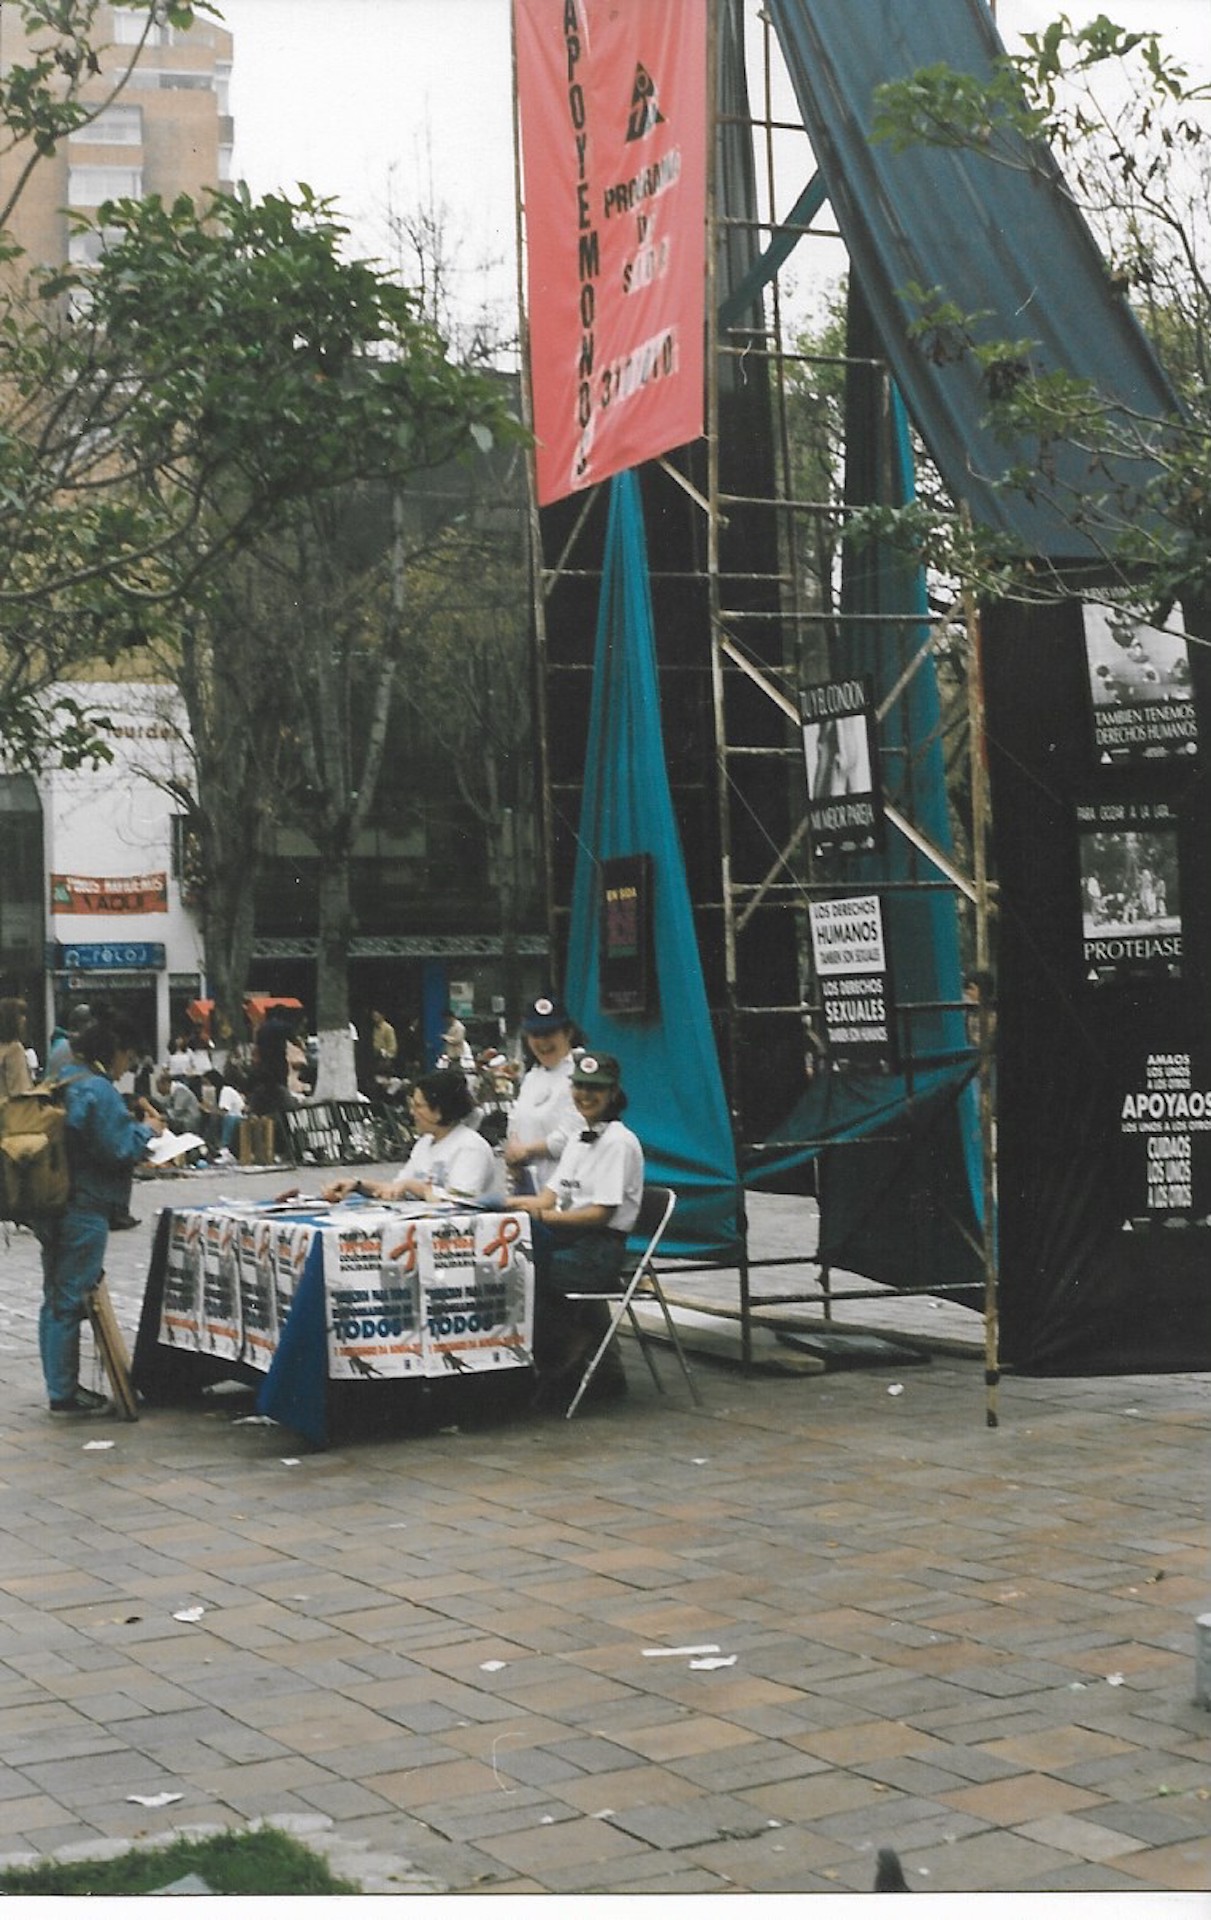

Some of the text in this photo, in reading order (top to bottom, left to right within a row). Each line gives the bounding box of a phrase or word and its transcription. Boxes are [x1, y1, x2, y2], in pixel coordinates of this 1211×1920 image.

[1094, 704, 1196, 727] TAMBIEN TENEMOS
[1095, 719, 1198, 746] DERECHOS HUMANOS
[814, 899, 876, 920] LOS DERECHOS
[815, 920, 878, 945] HUMANOS
[1083, 936, 1184, 962] PROTEJASE
[822, 977, 884, 997] LOS DERECHOS
[824, 998, 886, 1024] SEXUALES
[1146, 1053, 1191, 1066] AMAOS
[1146, 1065, 1191, 1079] LOS UNOS
[1121, 1122, 1138, 1133] LOS
[1138, 1121, 1163, 1133] UNOS
[1146, 1135, 1192, 1160] CUIDAOS
[1146, 1158, 1192, 1184] LOS UNOS
[332, 1318, 402, 1340] TODOS
[427, 1315, 494, 1338] TODOS
